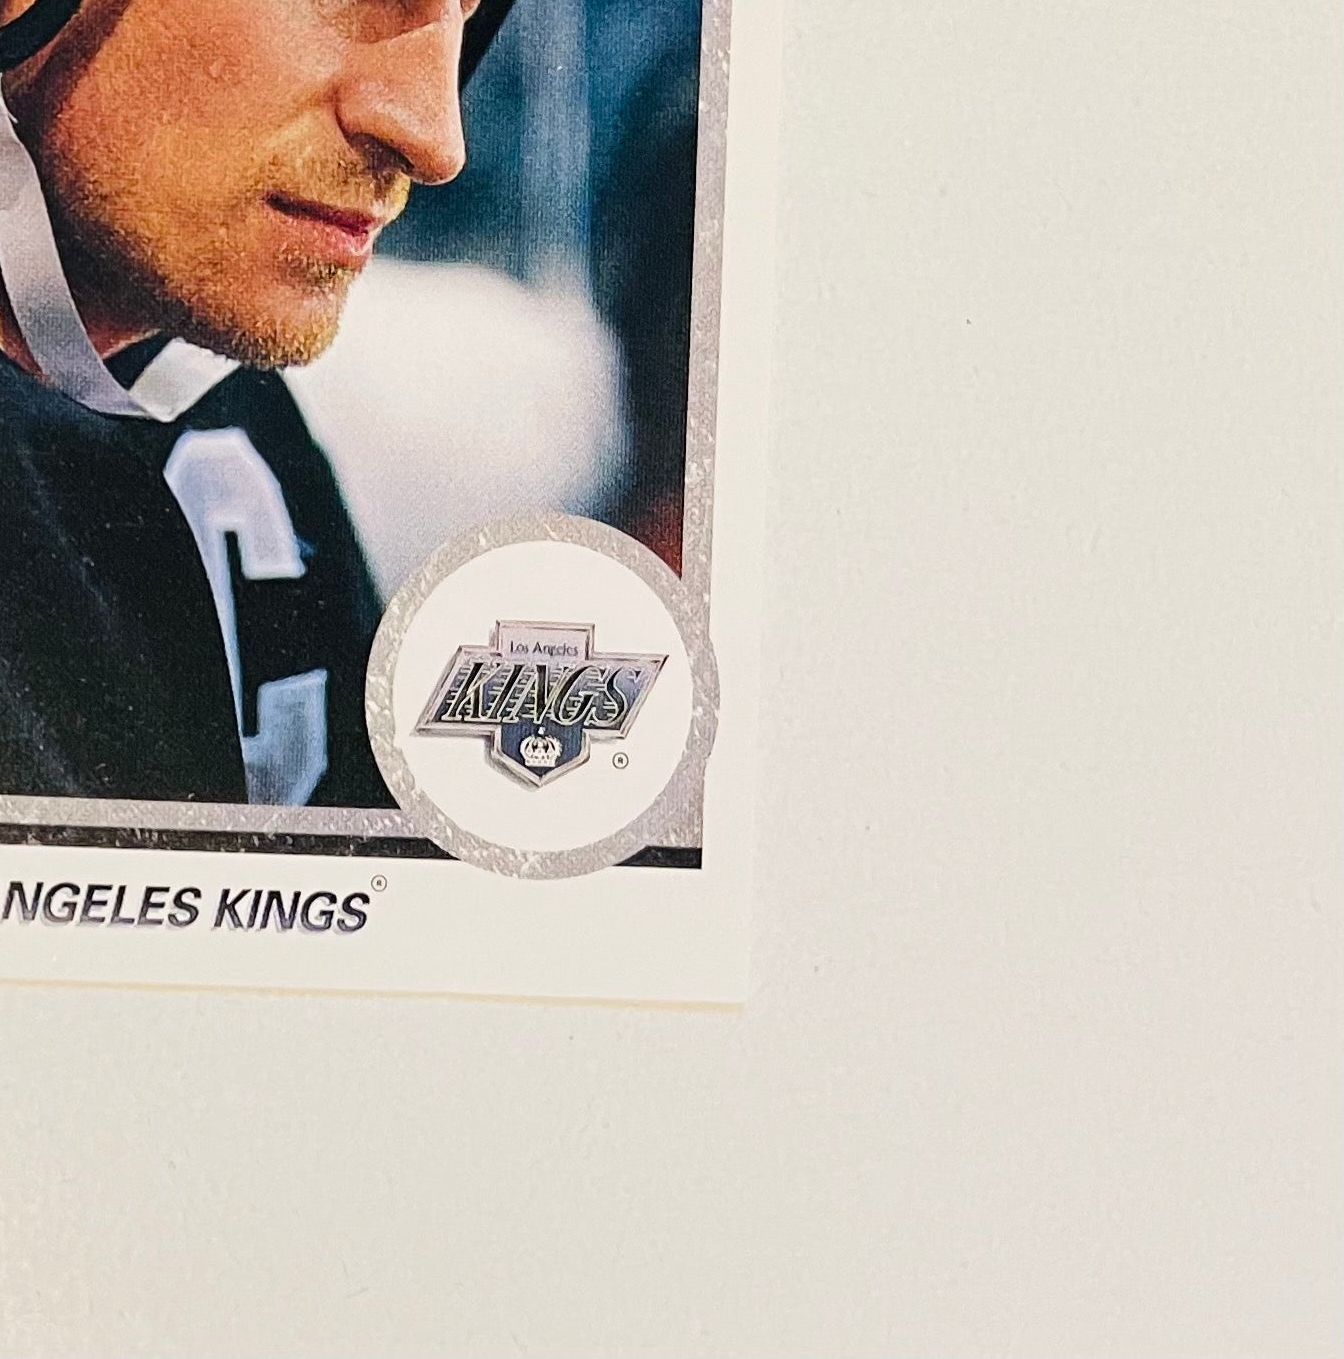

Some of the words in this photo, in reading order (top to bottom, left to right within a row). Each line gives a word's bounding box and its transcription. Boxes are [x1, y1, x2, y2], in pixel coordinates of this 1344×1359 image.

[163, 426, 329, 807] C
[509, 640, 530, 655] Los
[533, 641, 579, 657] Angeles
[442, 661, 641, 726] KINGS
[212, 888, 371, 933] KINGS
